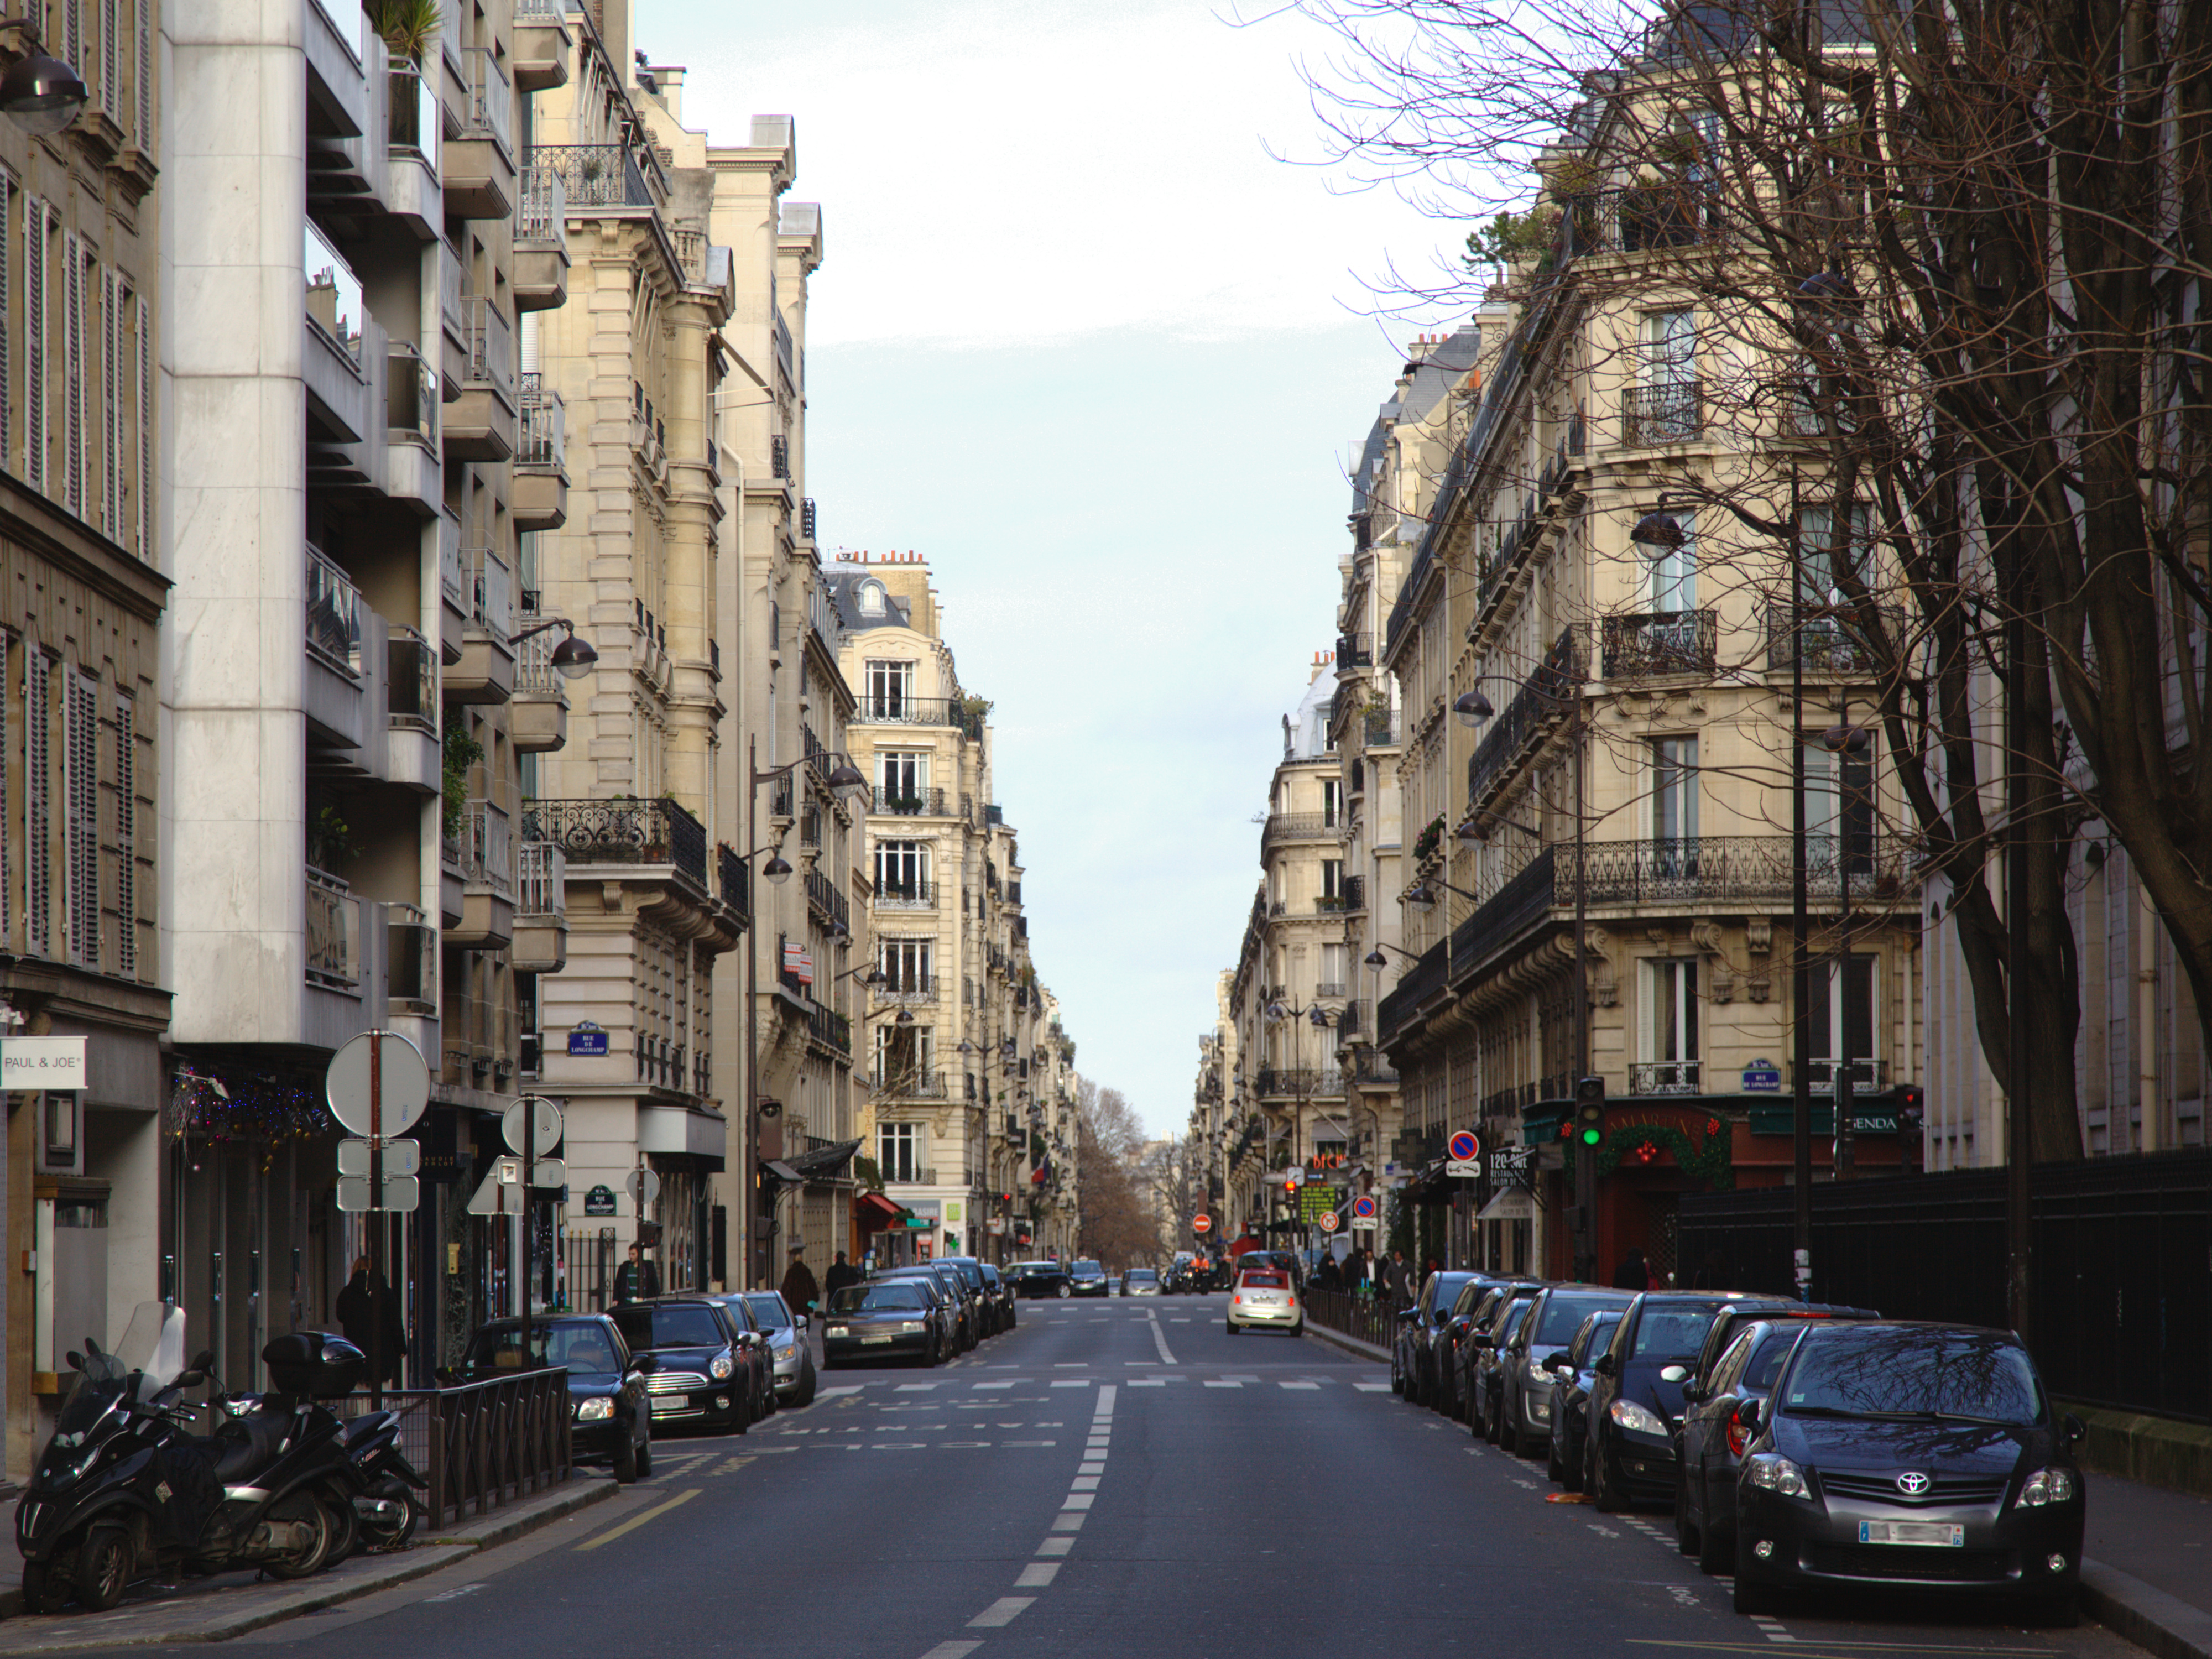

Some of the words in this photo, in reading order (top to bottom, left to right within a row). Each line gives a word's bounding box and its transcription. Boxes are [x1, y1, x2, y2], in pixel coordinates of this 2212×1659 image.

[4, 1057, 34, 1068] PAUL
[39, 1057, 48, 1068] &
[739, 1441, 1056, 1455] ECOLE
[1953, 1536, 1963, 1545] 75
